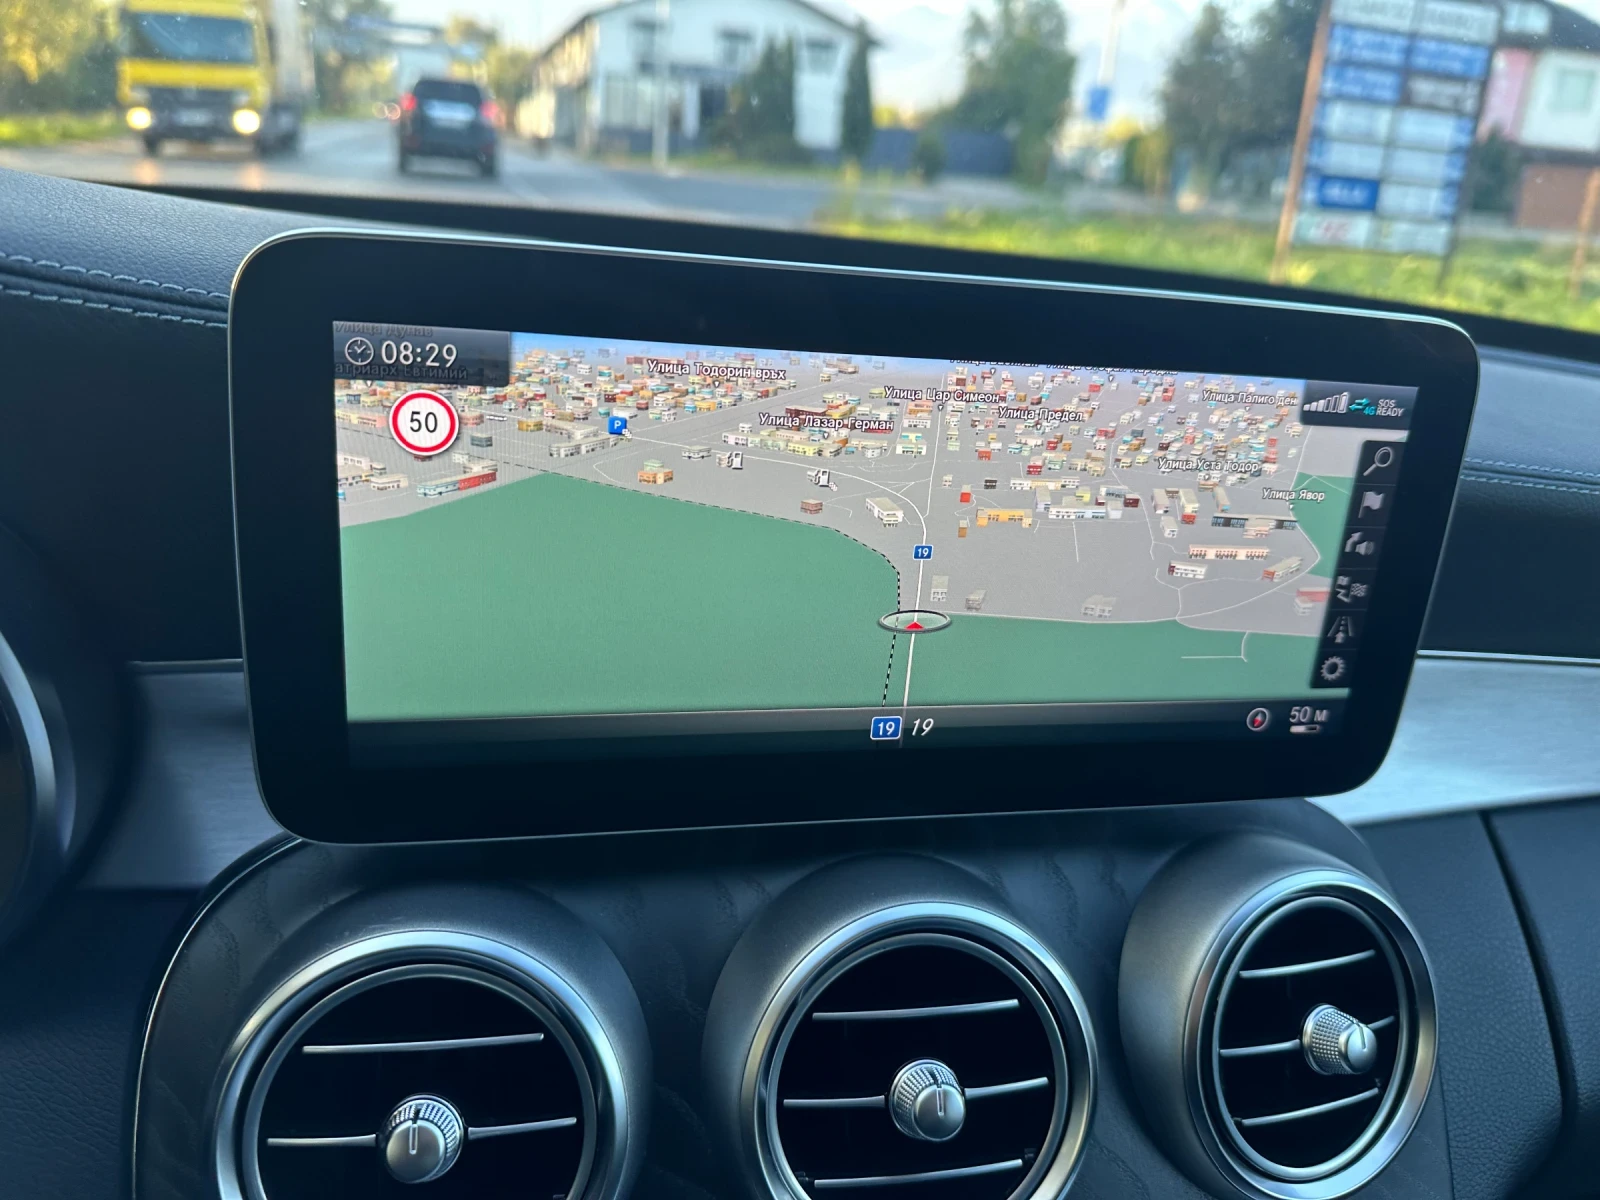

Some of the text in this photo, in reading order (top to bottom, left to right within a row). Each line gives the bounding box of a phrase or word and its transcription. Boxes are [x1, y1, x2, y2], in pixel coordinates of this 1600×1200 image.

[381, 340, 457, 368] 08:29
[648, 360, 786, 380] Улица Тодорин връх
[885, 387, 1000, 403] Улица Цар Симеон
[1202, 390, 1234, 404] Улица
[1378, 398, 1395, 408] SOS
[999, 408, 1083, 423] Улица Предел
[1363, 406, 1376, 416] 4G
[1376, 408, 1403, 417] READY
[409, 411, 438, 433] 50
[759, 413, 894, 432] Улица Лазар Герман
[1157, 458, 1259, 473] Улица Уста Тодор
[1262, 488, 1325, 502] Улица Явор
[917, 546, 929, 558] 19
[1289, 706, 1311, 723] 50
[878, 721, 896, 735] 19
[911, 718, 934, 737] 19
